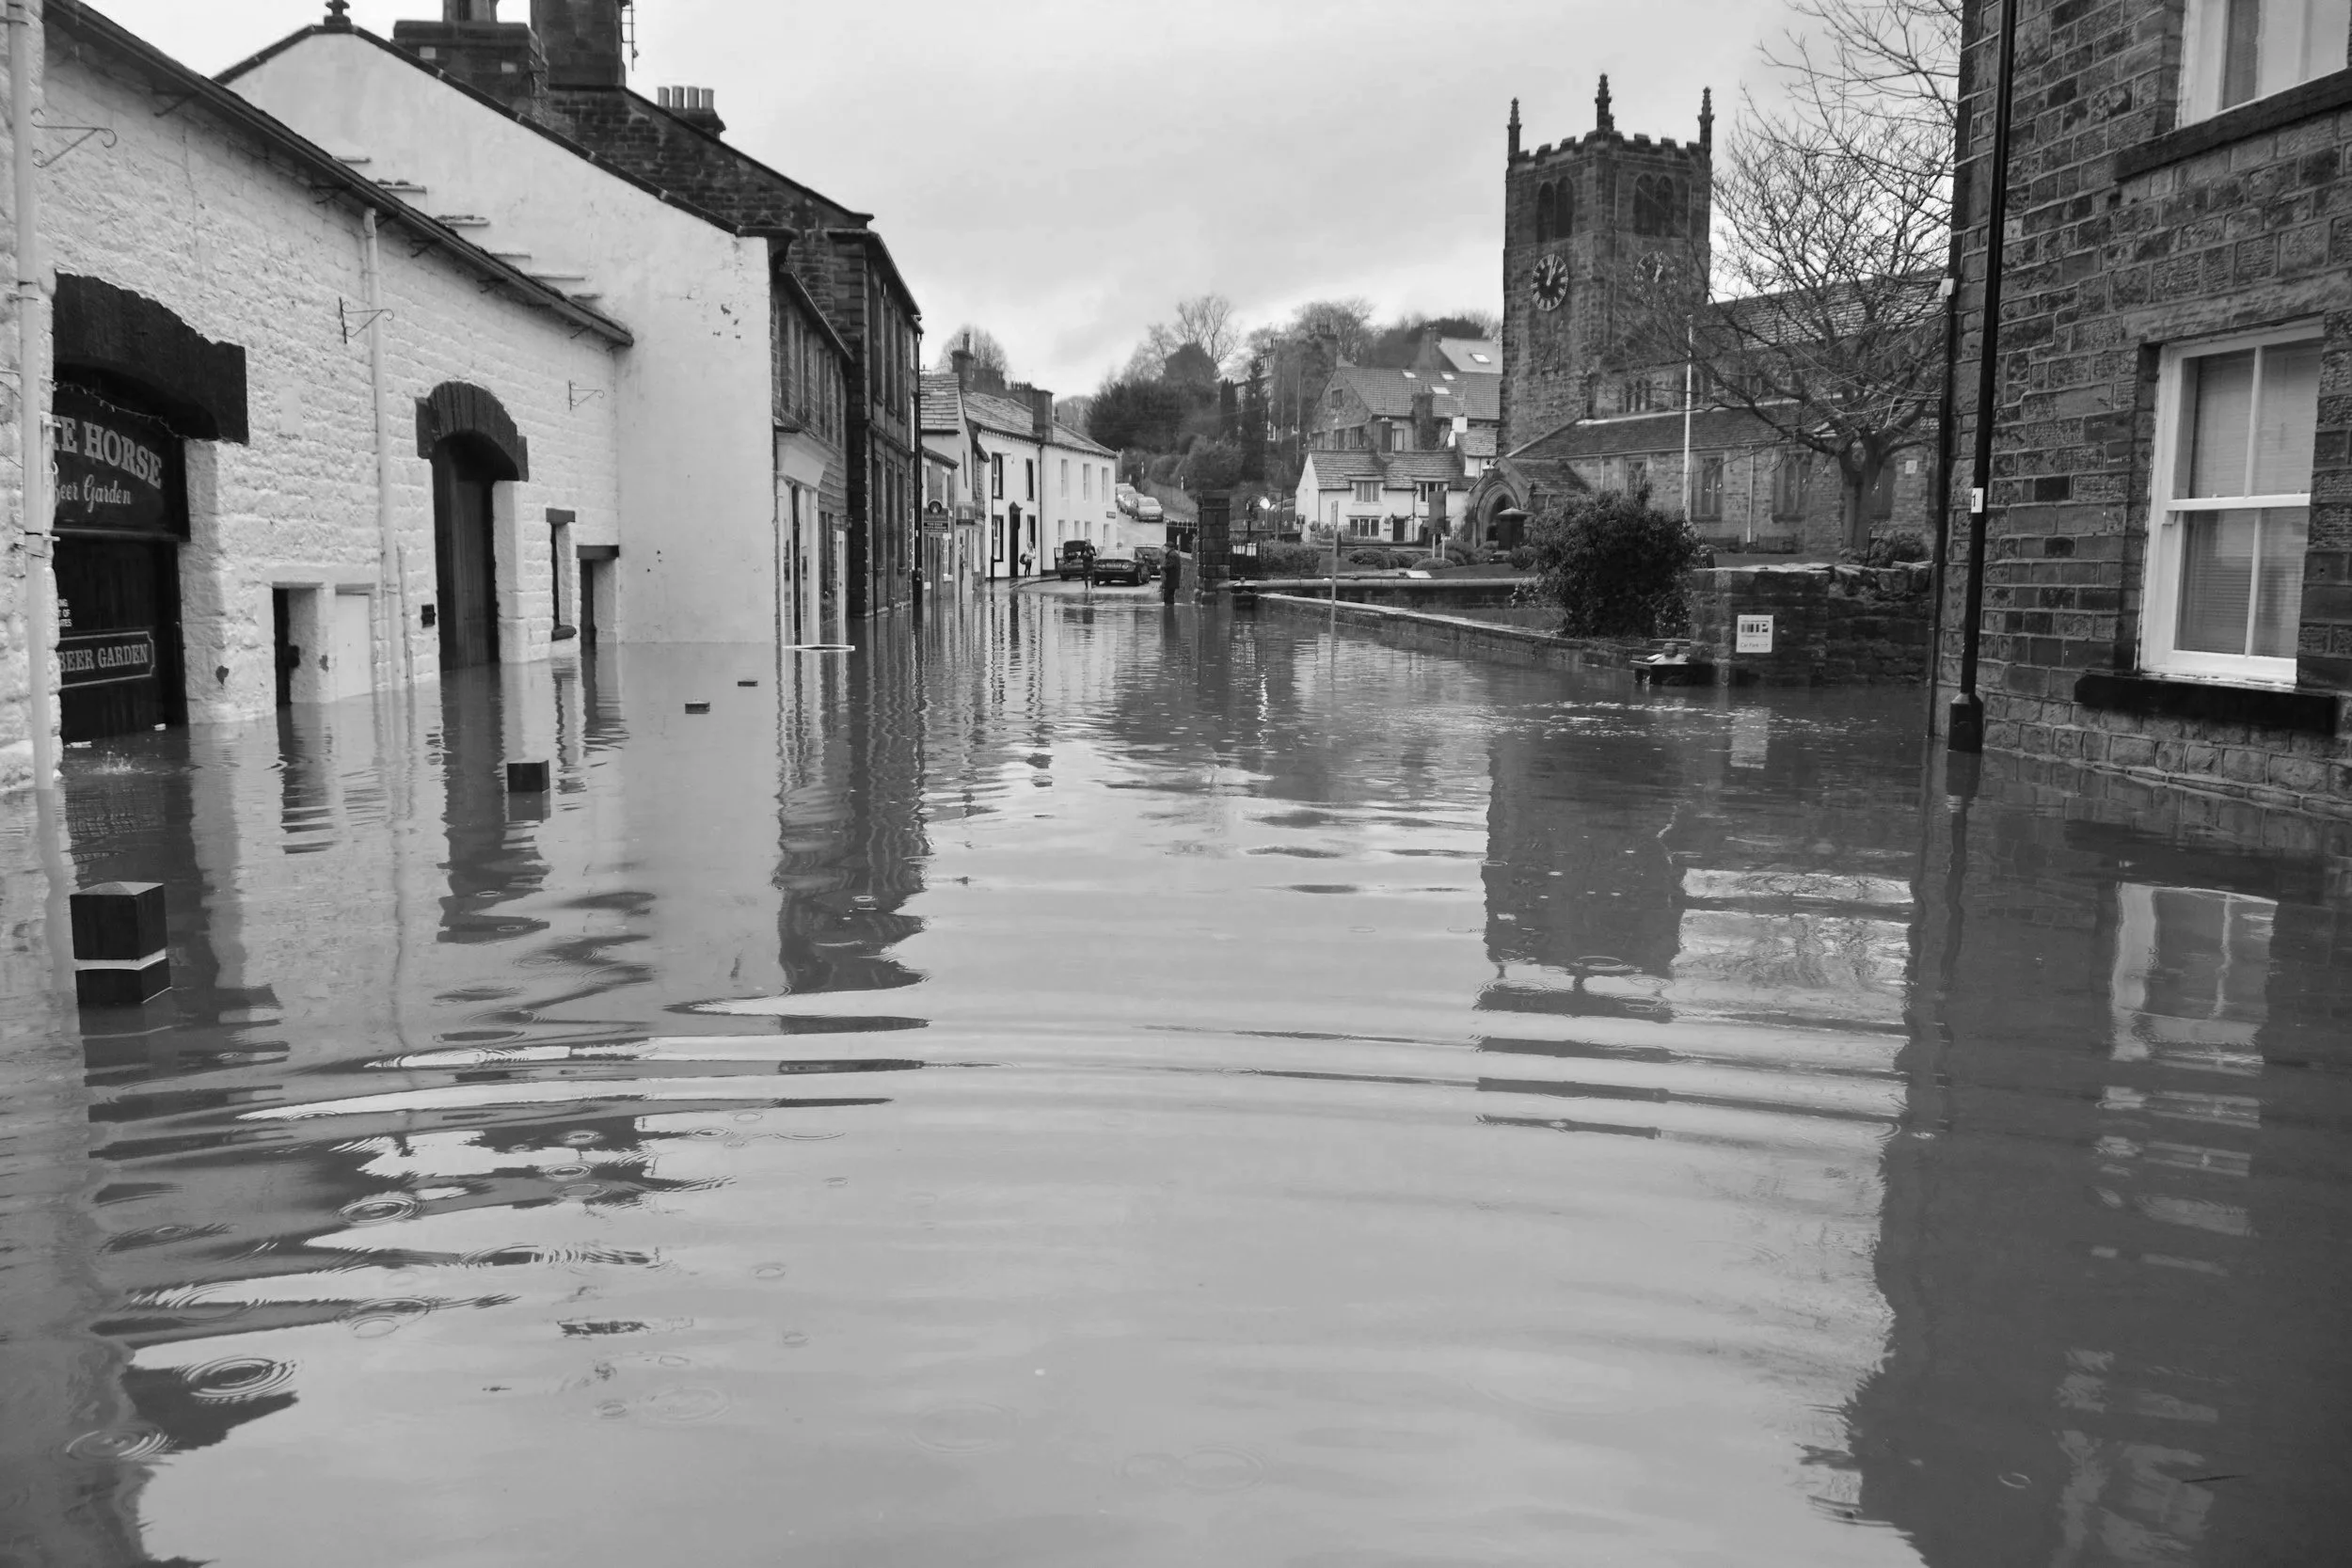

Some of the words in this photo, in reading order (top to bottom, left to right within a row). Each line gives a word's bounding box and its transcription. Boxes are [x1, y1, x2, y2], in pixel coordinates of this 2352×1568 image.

[83, 420, 162, 489] HORSE
[84, 474, 131, 513] Garden
[56, 649, 95, 673] BEER
[98, 643, 148, 669] GARDEN
